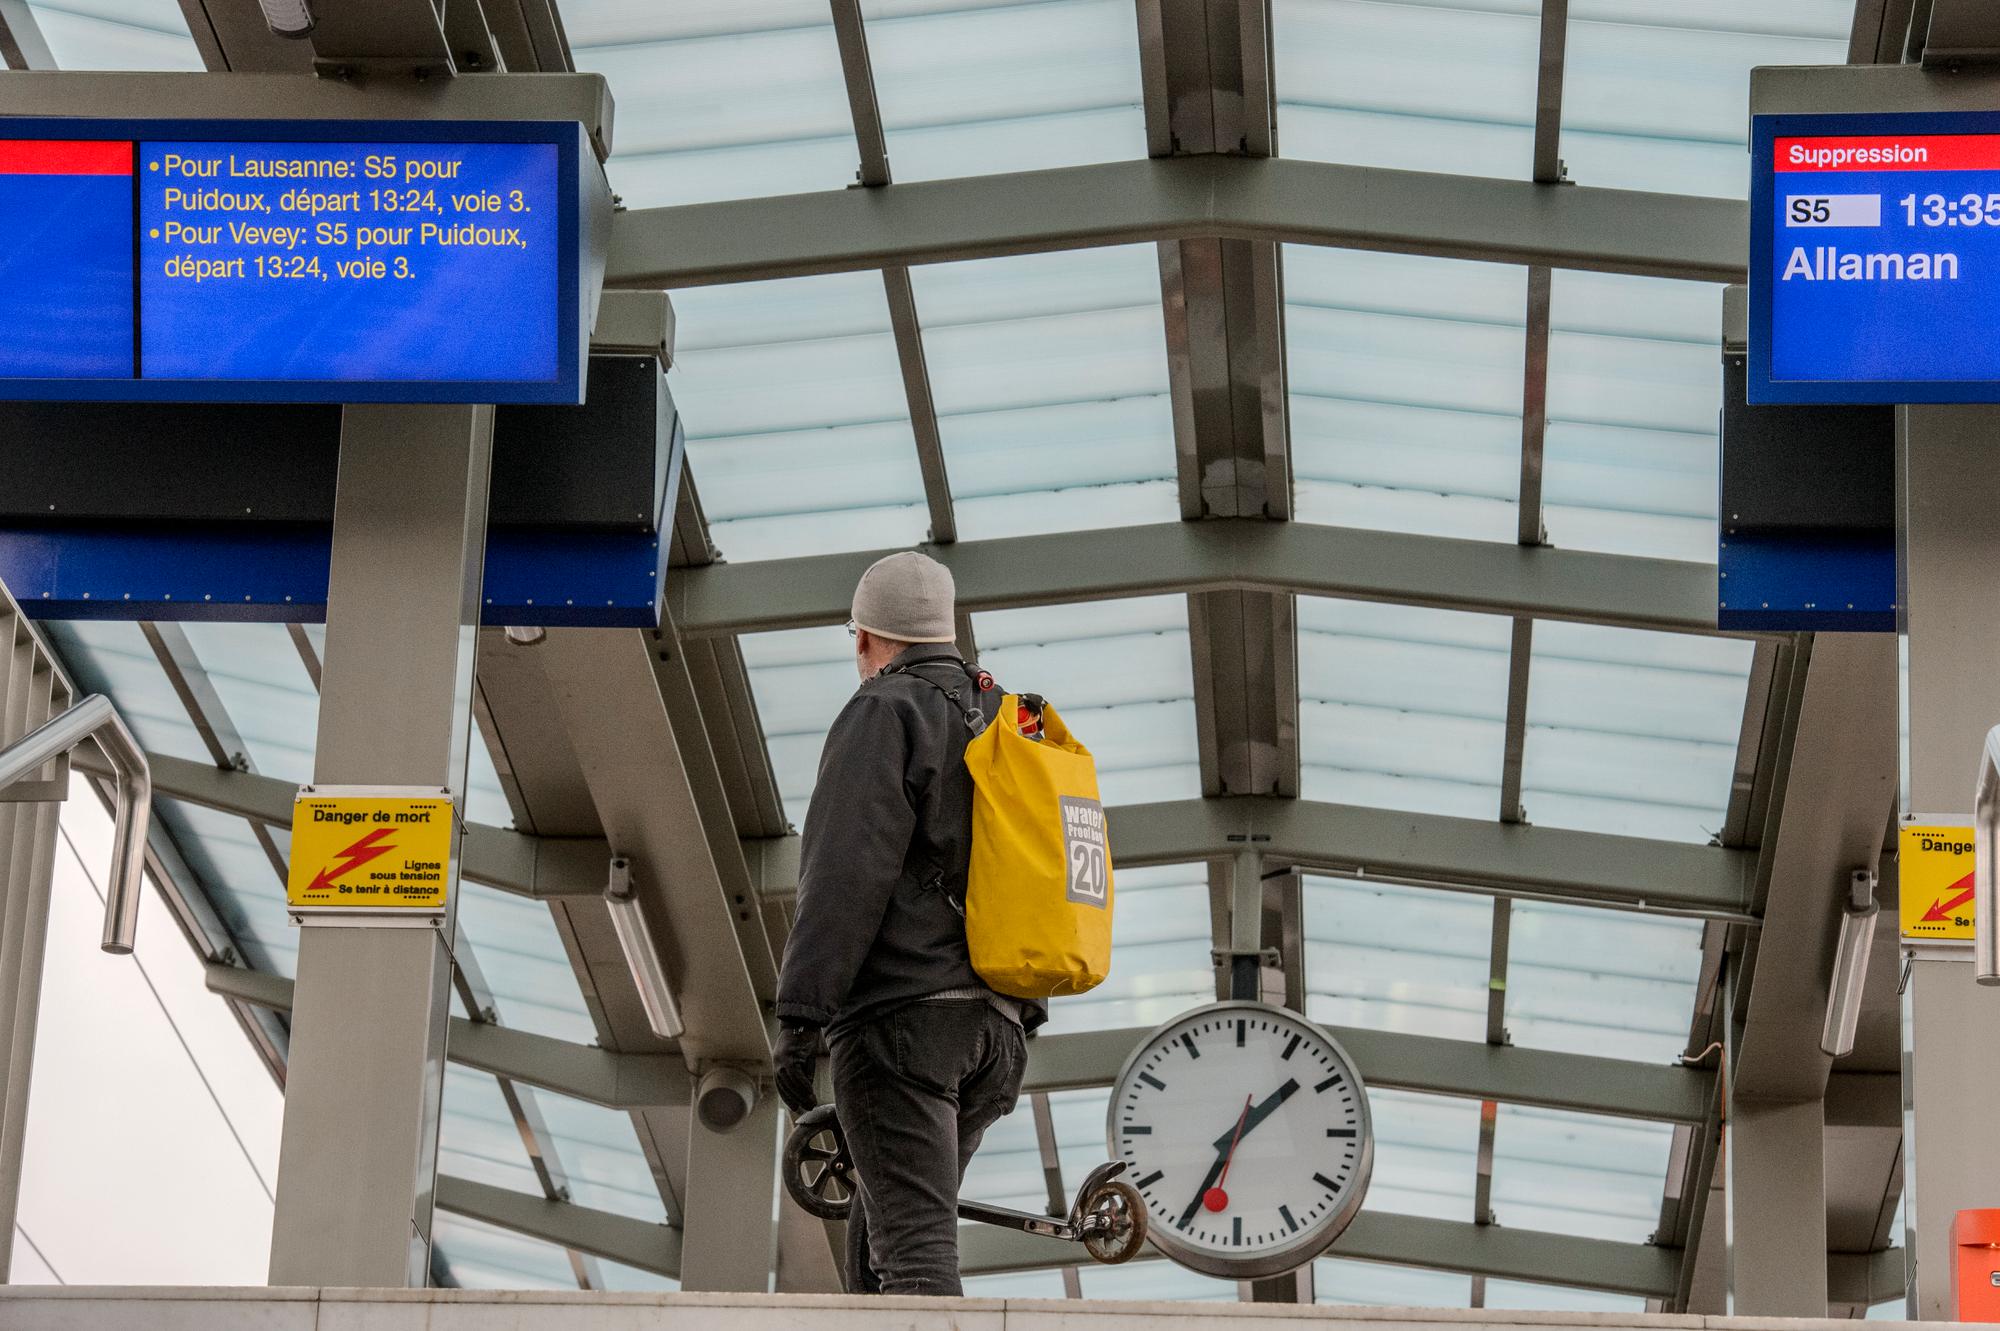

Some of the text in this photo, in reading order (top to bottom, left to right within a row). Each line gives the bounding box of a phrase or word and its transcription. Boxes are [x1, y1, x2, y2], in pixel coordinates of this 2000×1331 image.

[164, 154, 462, 183] Pour Lausanne: S5 pour
[1789, 144, 1928, 167] Suppression
[164, 187, 531, 217] Puidoux, départ 13:24, voie 3.
[1791, 193, 2000, 227] S5 13:35
[165, 221, 527, 251] Pour Vevey: S5 pour Puidoux,
[164, 254, 416, 284] départ 13:24, voie 3.
[1782, 246, 1958, 281] Allaman
[313, 809, 430, 825] Danger de mort
[1921, 839, 1975, 855] Dange
[370, 871, 440, 881] sous tension
[404, 860, 441, 874] Lignes
[1074, 844, 1104, 894] 20
[338, 884, 439, 895] Se tenir à distance
[1954, 916, 1970, 926] Se
